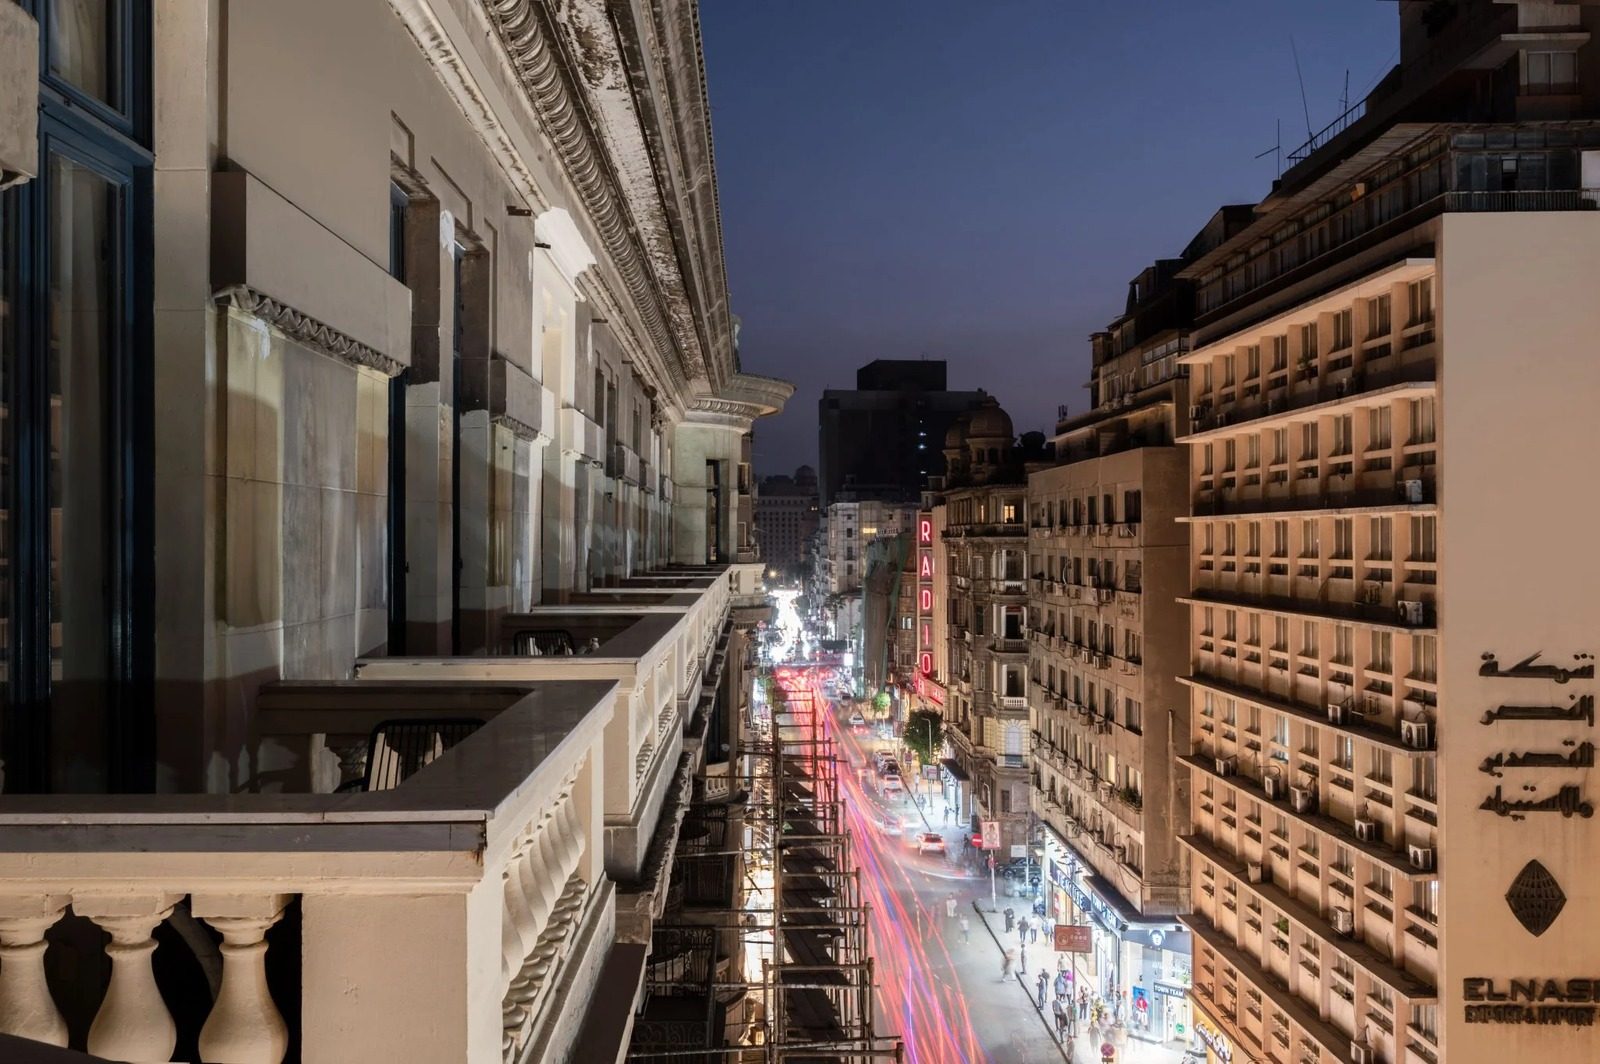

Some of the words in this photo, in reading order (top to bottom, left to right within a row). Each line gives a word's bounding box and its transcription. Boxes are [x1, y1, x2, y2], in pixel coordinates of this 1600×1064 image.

[921, 520, 932, 674] RADIO
[1479, 650, 1594, 684] شركة
[1479, 694, 1594, 727] النصر
[1478, 740, 1594, 778] للتصدير
[1479, 785, 1594, 822] والاستيراد
[1463, 977, 1600, 1002] ELNAS
[1538, 1006, 1594, 1026] IMPORT
